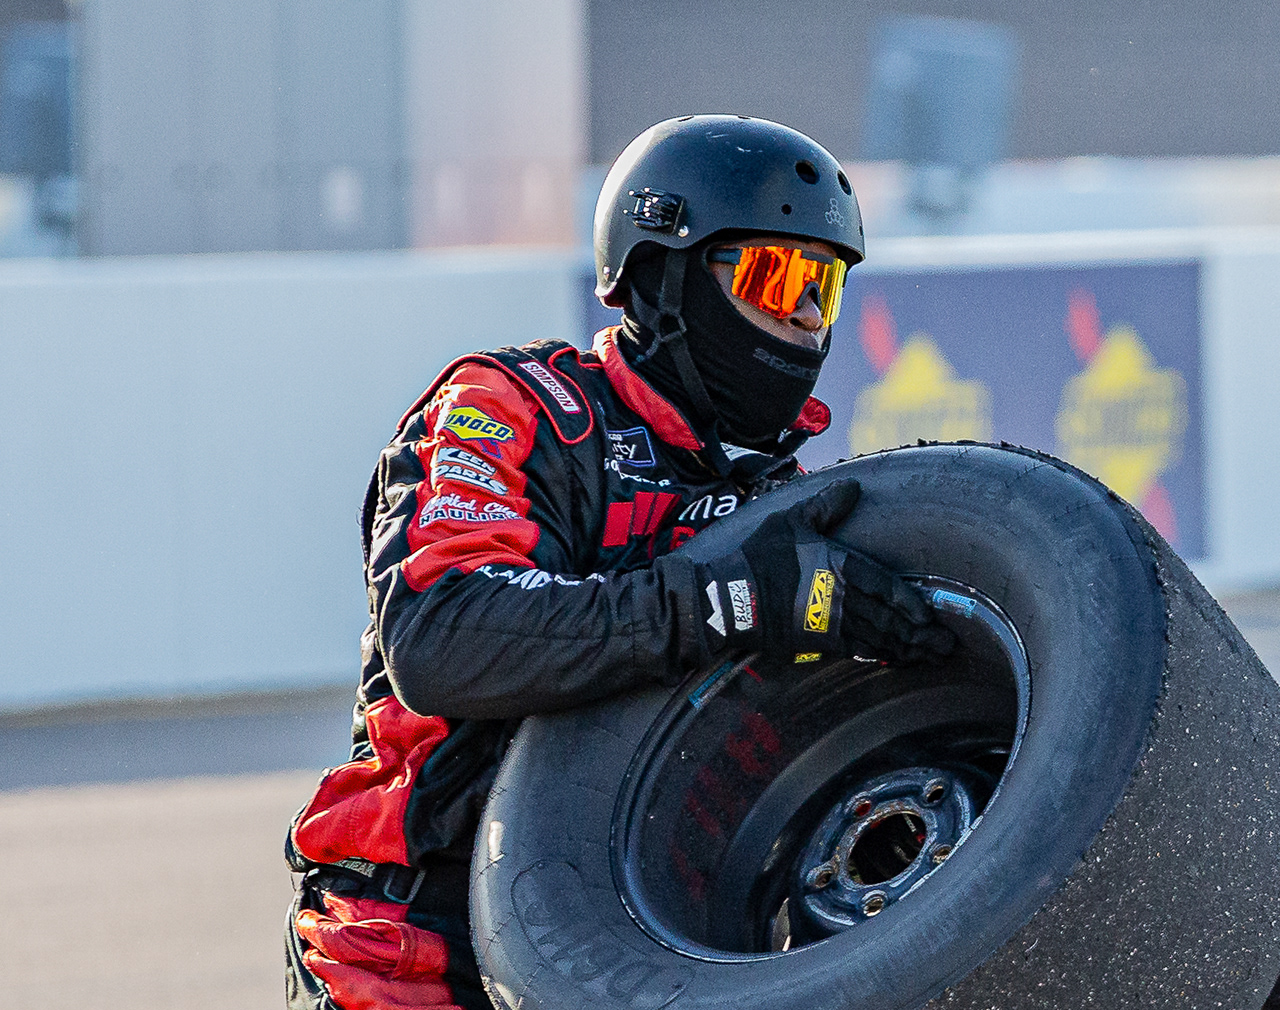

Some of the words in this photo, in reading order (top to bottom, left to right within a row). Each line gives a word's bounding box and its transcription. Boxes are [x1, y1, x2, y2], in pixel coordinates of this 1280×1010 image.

[524, 362, 575, 411] SIMPSON
[448, 413, 511, 438] NOCO
[437, 447, 495, 474] KEEN
[436, 465, 508, 495] PARTS
